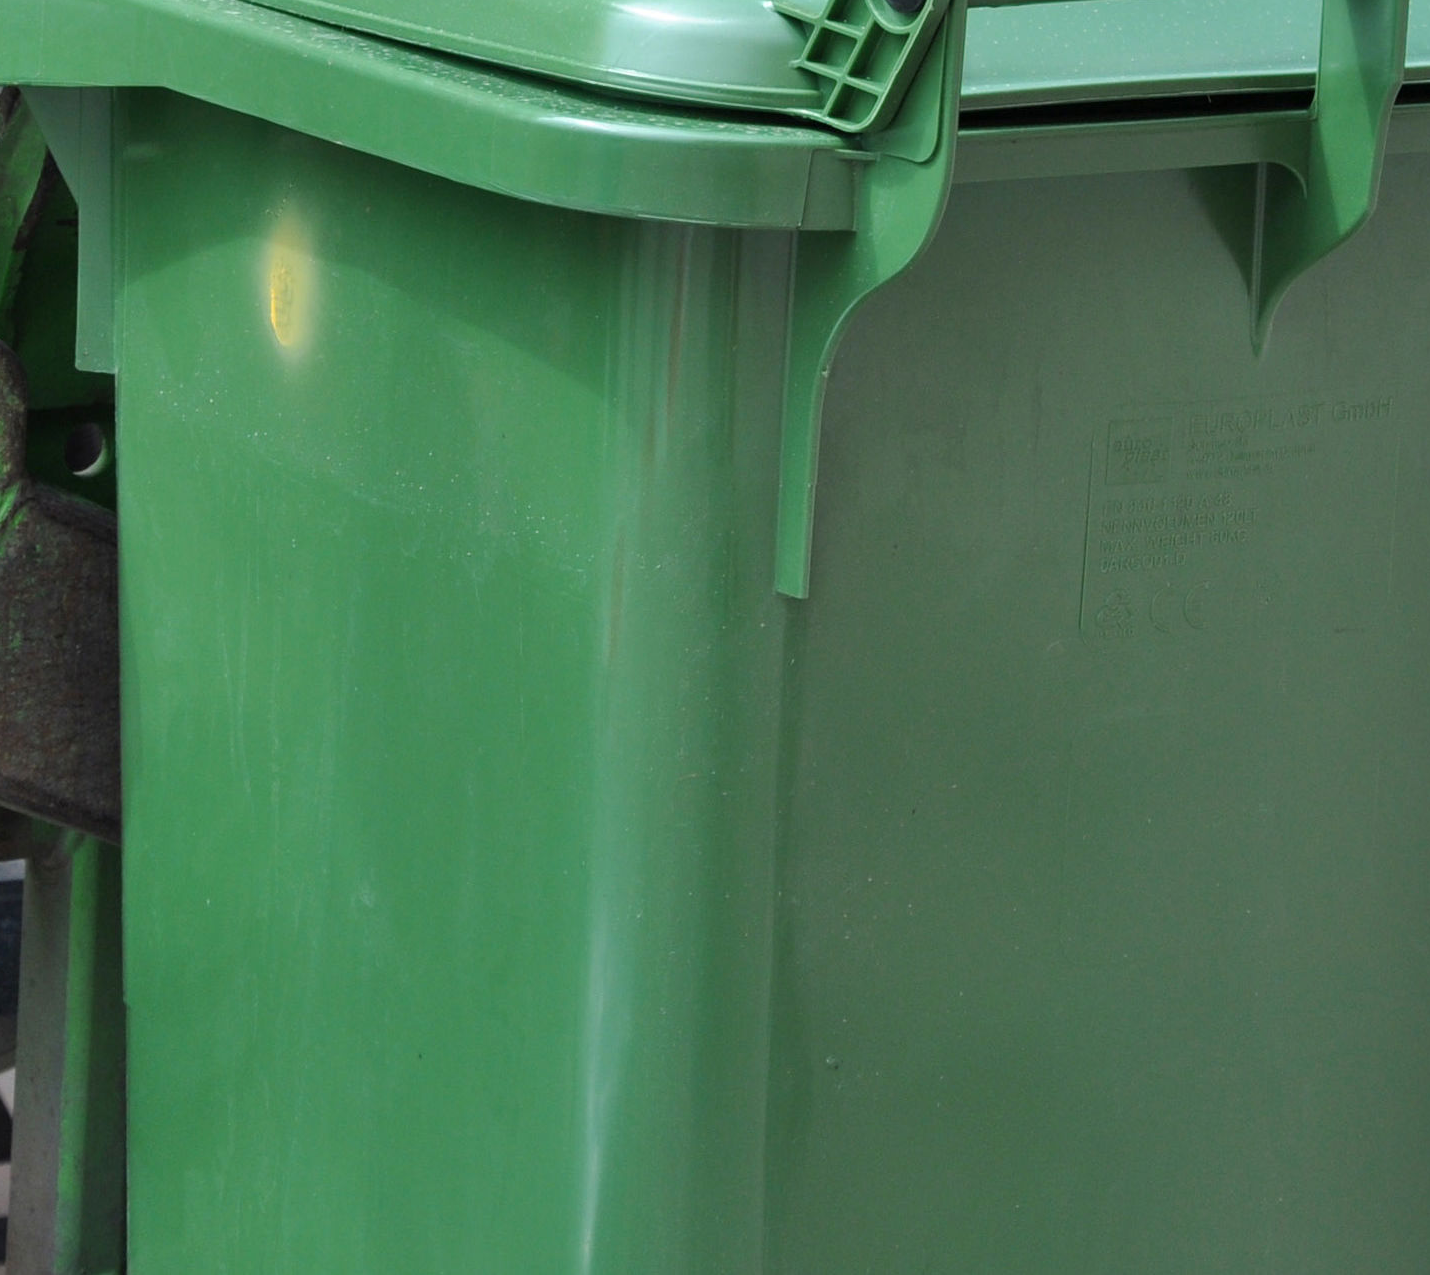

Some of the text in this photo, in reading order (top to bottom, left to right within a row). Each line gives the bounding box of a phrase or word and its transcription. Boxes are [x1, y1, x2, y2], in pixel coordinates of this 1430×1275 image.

[1189, 396, 1394, 436] EUROPLAST GmbH
[1101, 512, 1216, 535] NENNVOLUMEN
